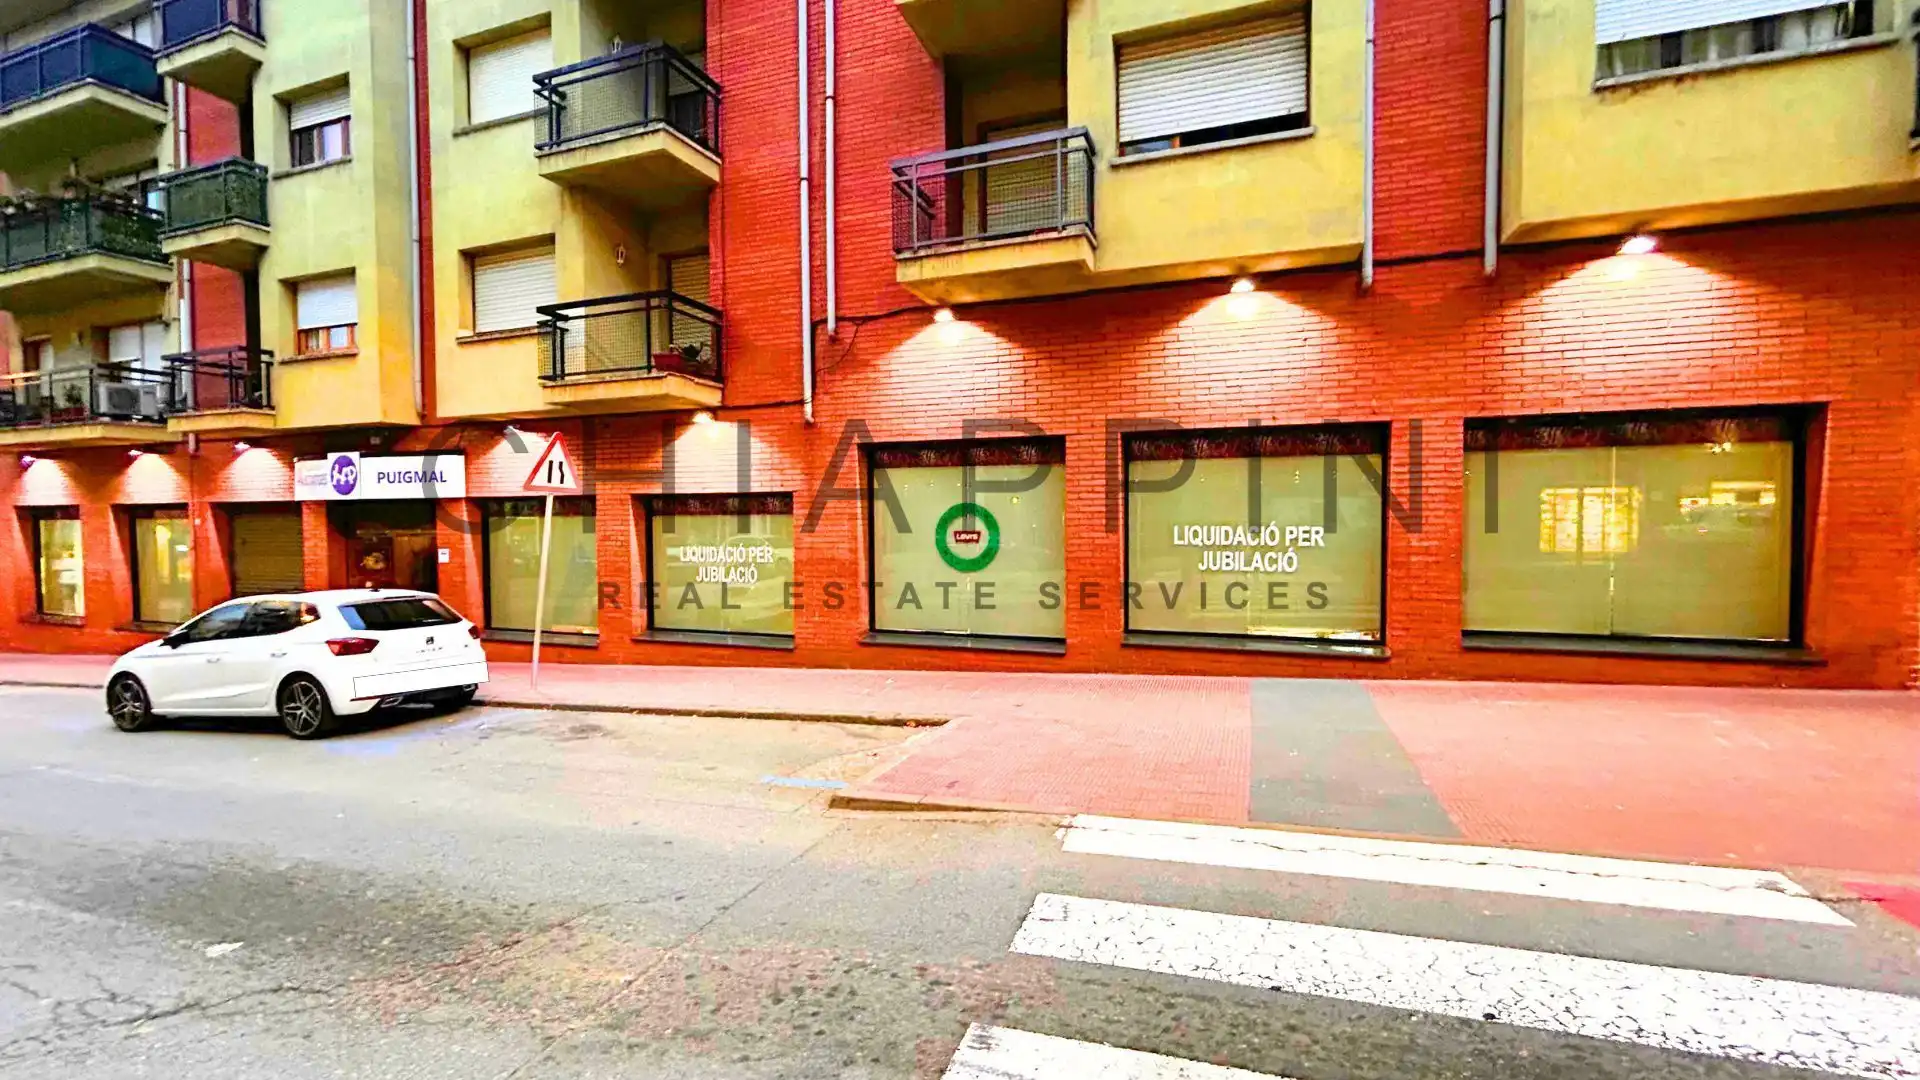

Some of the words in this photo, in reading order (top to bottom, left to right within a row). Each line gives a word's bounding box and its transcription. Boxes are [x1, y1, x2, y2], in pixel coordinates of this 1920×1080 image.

[376, 470, 447, 484] PUIGMAL
[1173, 521, 1280, 548] LIQUIDACIÓ
[1285, 525, 1325, 547] PER
[680, 544, 746, 564] LIQUIDACIÓ
[749, 546, 773, 563] PER
[1198, 547, 1298, 573] JUBILACIÓ
[696, 564, 758, 583] JUBILACIÓ
